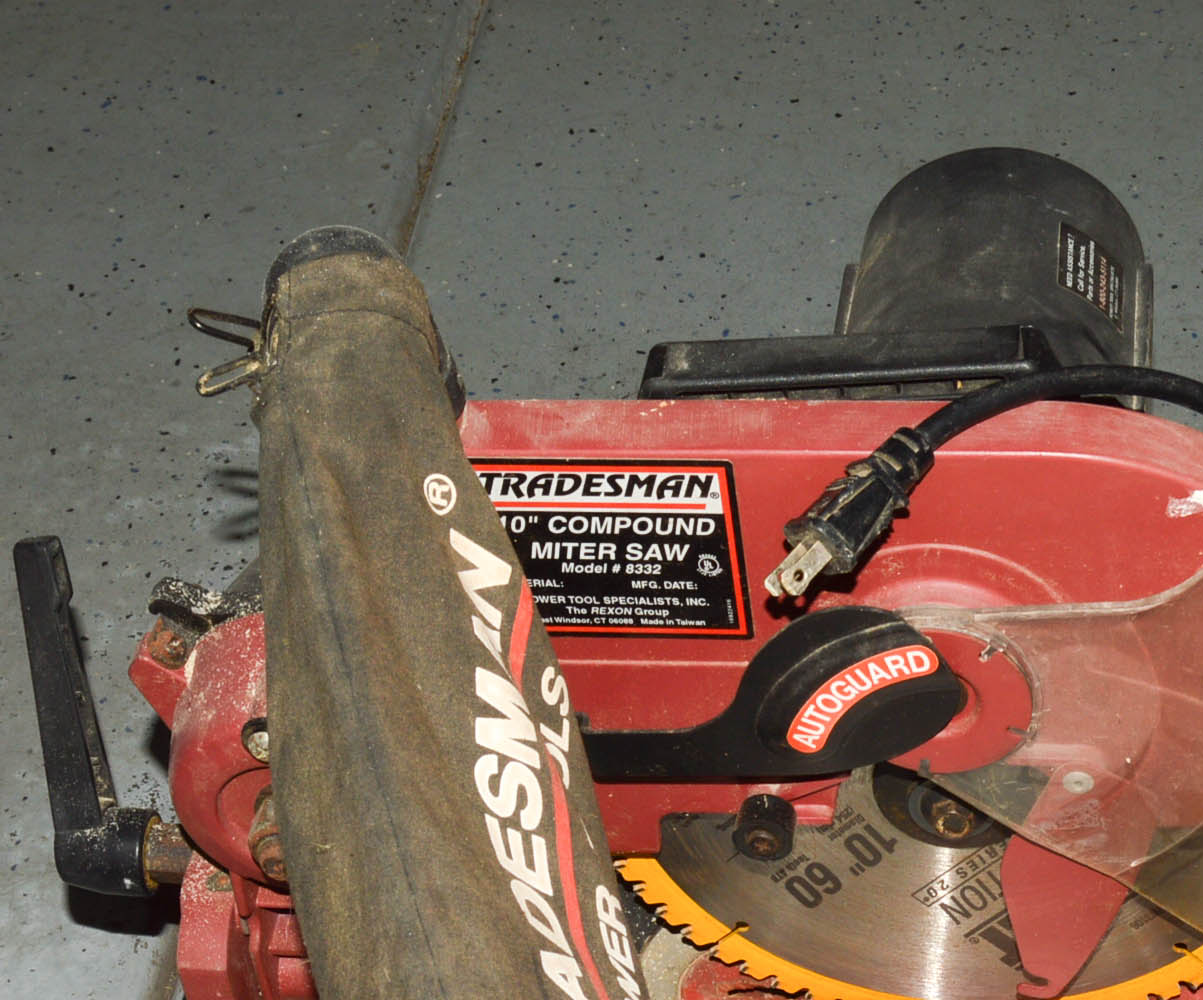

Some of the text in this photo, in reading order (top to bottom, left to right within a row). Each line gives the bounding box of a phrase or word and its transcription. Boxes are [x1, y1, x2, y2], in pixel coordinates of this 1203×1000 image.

[548, 515, 716, 537] COMPOUND
[531, 541, 690, 562] MITER SAW
[561, 562, 608, 574] Model
[625, 563, 662, 575] 8332
[527, 578, 564, 588] ERIAL:
[631, 580, 698, 590] MFG. DATE:
[532, 595, 566, 604] OWER
[567, 595, 600, 605] TOOL
[686, 597, 710, 607] INC.
[566, 606, 670, 618] The REXON Group
[594, 617, 606, 625] CT
[675, 618, 706, 626] Taiwan
[792, 650, 931, 749] AUTOGUARD
[784, 861, 843, 909] 60
